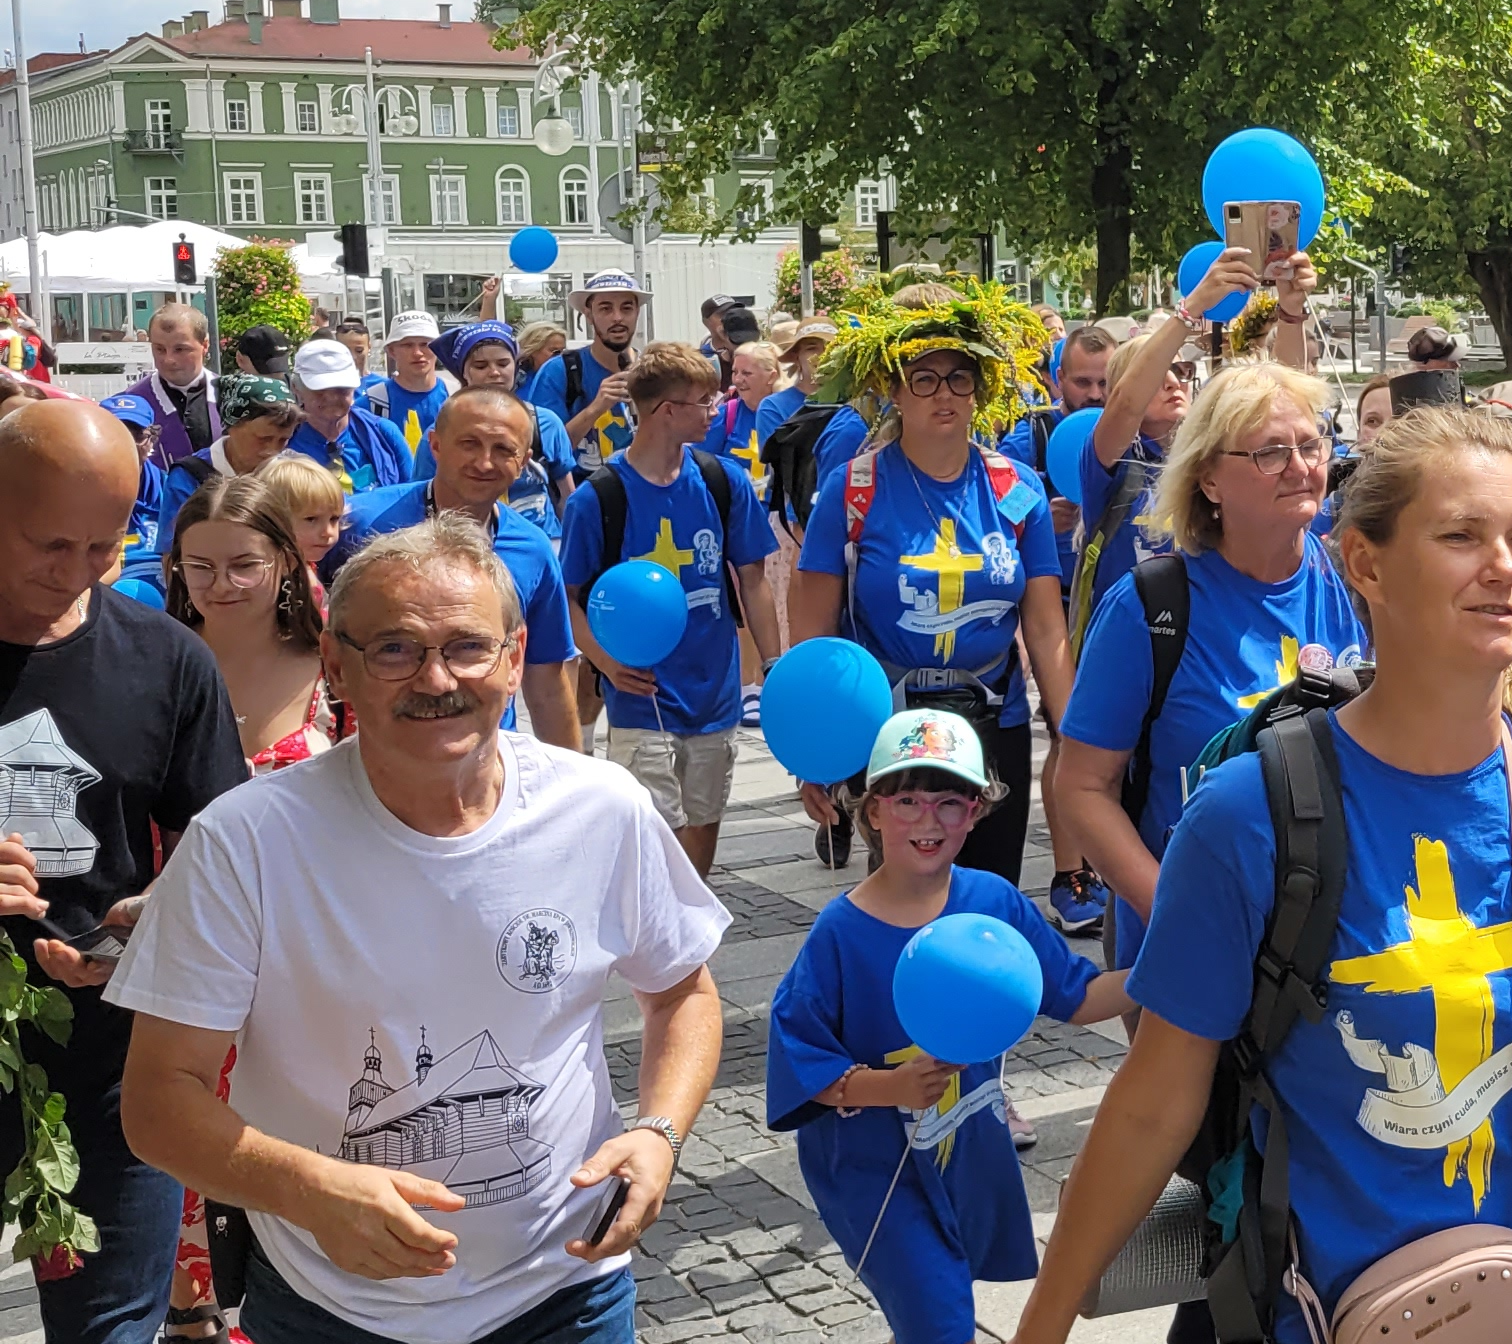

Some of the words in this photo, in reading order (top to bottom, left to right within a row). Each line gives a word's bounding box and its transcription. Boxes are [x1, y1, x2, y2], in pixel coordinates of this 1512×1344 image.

[1383, 1118, 1419, 1135] Wiara
[1421, 1115, 1454, 1135] czyni
[1454, 1098, 1479, 1121] cuda,
[1476, 1065, 1509, 1098] musisz
